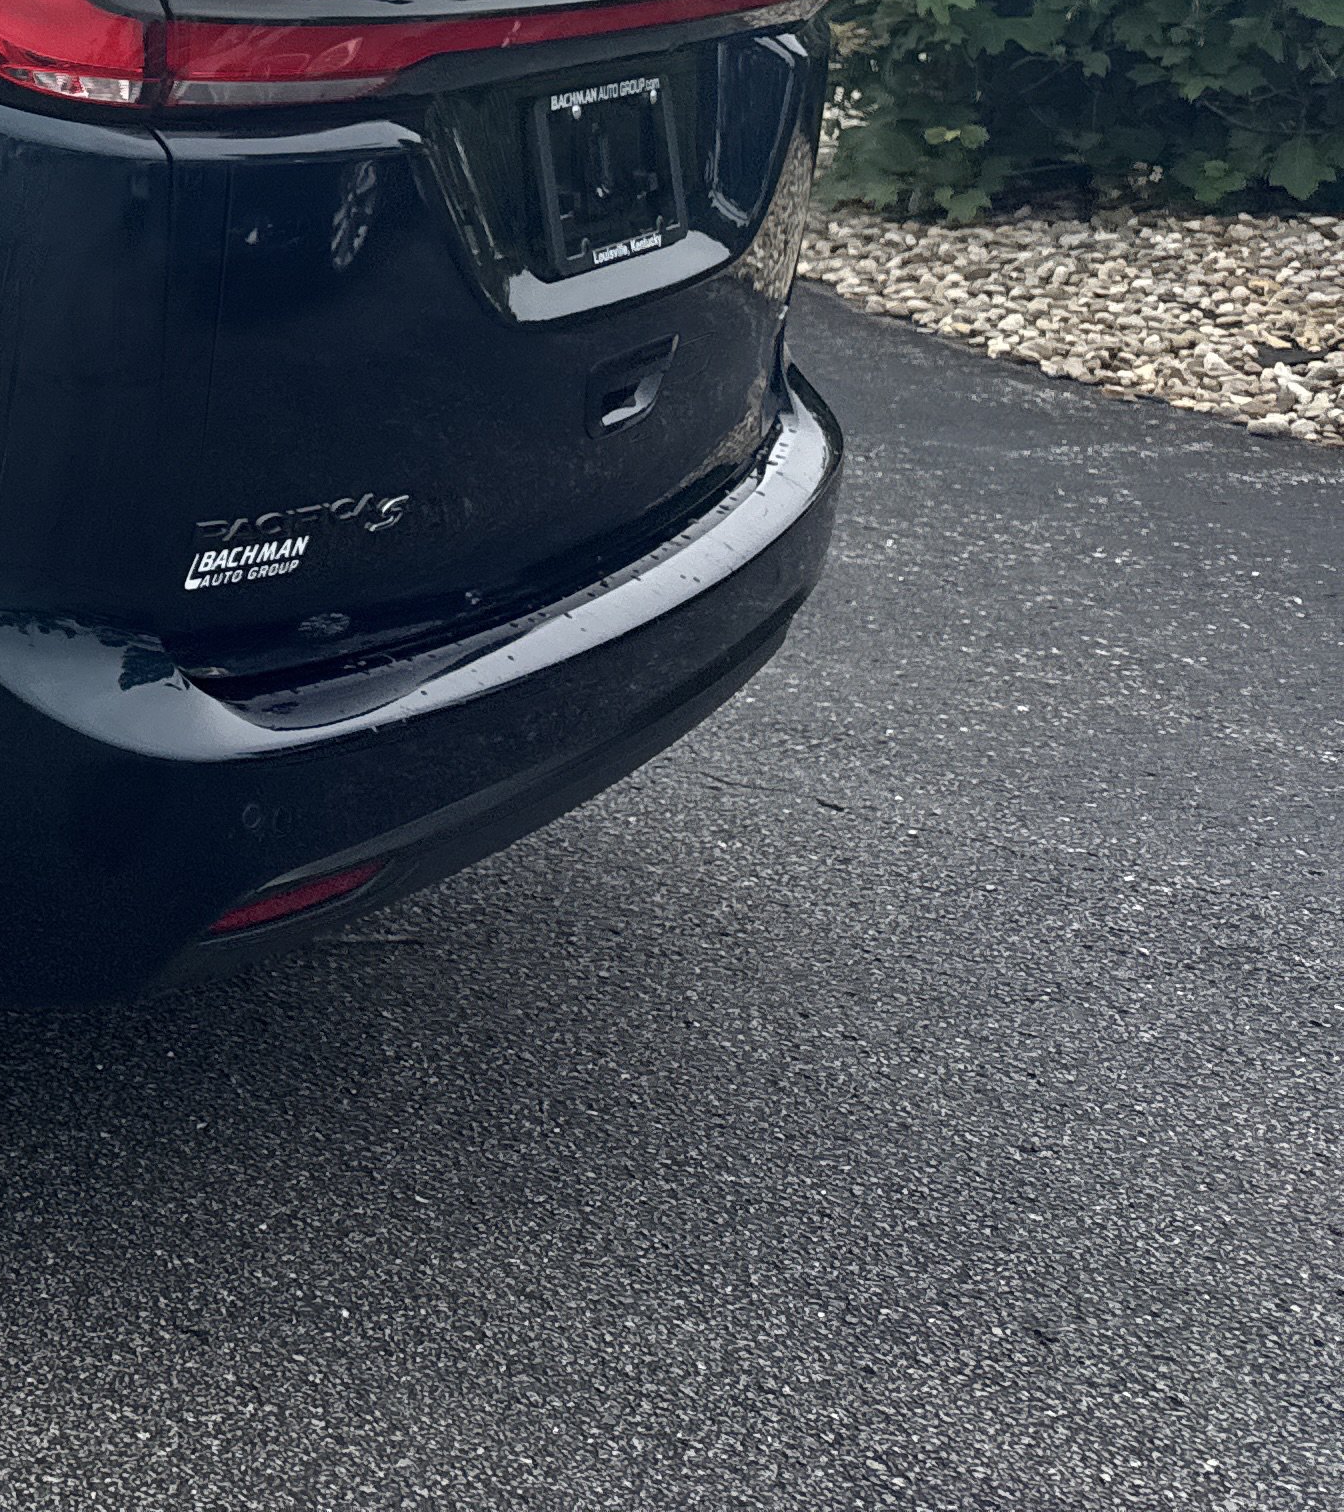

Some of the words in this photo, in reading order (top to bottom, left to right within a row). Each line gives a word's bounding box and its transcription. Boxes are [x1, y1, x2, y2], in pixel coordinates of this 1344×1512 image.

[550, 88, 598, 111] BACHMAN
[598, 83, 619, 102] AUTO
[619, 77, 660, 97] GROUP.com
[630, 233, 662, 253] Kentucky
[197, 535, 310, 573] BACHMAN
[200, 569, 243, 589] AUTO
[247, 559, 300, 581] GROUP
